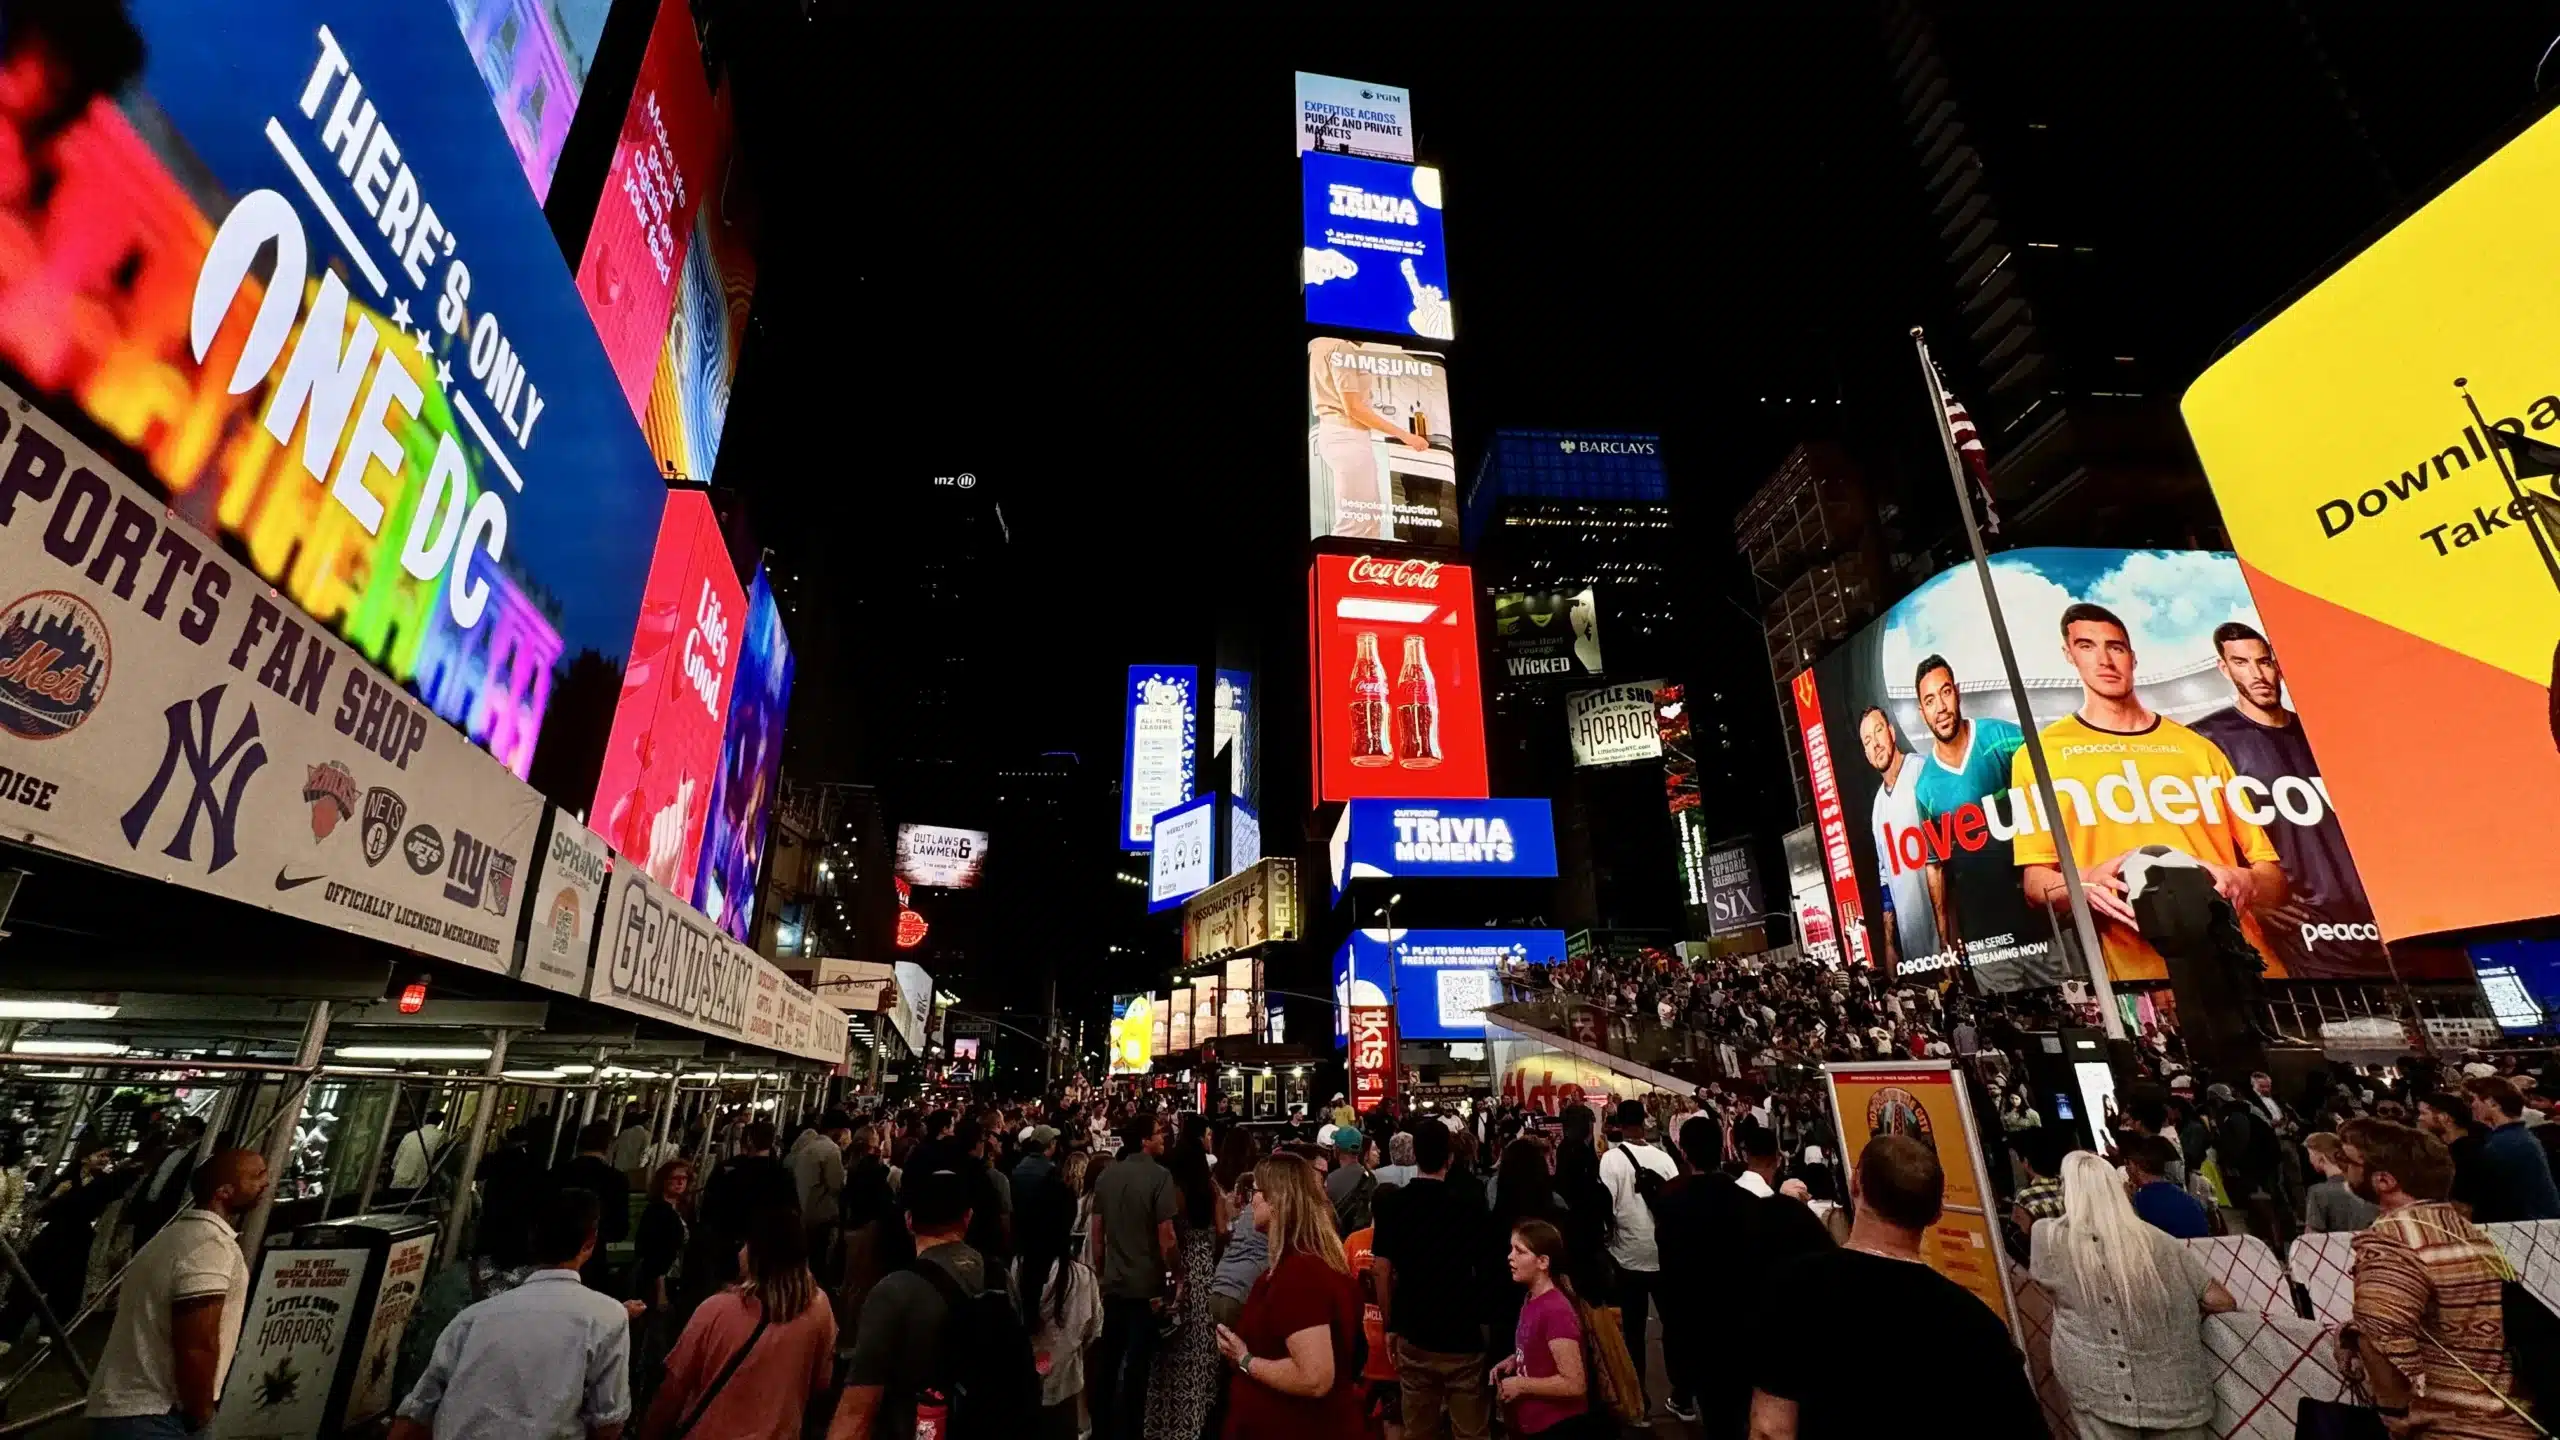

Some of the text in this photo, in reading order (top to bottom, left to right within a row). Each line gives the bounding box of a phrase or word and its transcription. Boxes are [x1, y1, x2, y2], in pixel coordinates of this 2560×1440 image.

[1304, 100, 1396, 125] EXPERTISE ACROSS
[1375, 92, 1401, 103] PGIM
[1304, 112, 1404, 137] PUBLIC AND PRIVATE
[1304, 124, 1352, 140] MARKETS
[648, 89, 686, 208] Make life
[648, 145, 674, 212] good
[635, 150, 674, 258] again on
[299, 24, 545, 450] THERE'S ONLY
[623, 167, 671, 286] your feed
[1331, 351, 1433, 377] SAMSUNG
[190, 189, 507, 628] ONE DC
[1579, 441, 1655, 455] BARCLAYS
[1391, 503, 1438, 516] nduction
[1411, 516, 1443, 528] Home
[0, 406, 428, 771] PORTS FAN SHOP
[1348, 554, 1444, 590] Coca-Cola
[698, 576, 728, 665] Life's
[0, 639, 89, 705] Mets
[1577, 687, 1655, 717] LITTLE SHO
[1579, 709, 1659, 757] HORROR
[2062, 740, 2128, 761] peacock
[1806, 722, 1842, 819] HERSHEY'S
[365, 792, 404, 832] NETS
[914, 833, 971, 859] OUTLAWS &
[1393, 817, 1513, 843] TRIVIA
[912, 844, 958, 859] LAWMEN
[1395, 841, 1515, 862] MOMENTS
[1825, 819, 1851, 882] STORE
[324, 880, 501, 956] OFFICIALLY LICENSED MERCHANDISE
[1192, 894, 1232, 923] MISSIONARY
[1232, 882, 1256, 906] STYLE
[1412, 946, 1435, 956] PLAY
[1435, 946, 1448, 956] TO
[1965, 933, 2015, 953] NEW SERIES
[1968, 941, 2049, 968] STREAMING NOW
[1896, 944, 1962, 977] peacock
[1360, 1008, 1390, 1070] tkts
[265, 1295, 310, 1318] LITTLE
[257, 1317, 335, 1356] HORRORS
